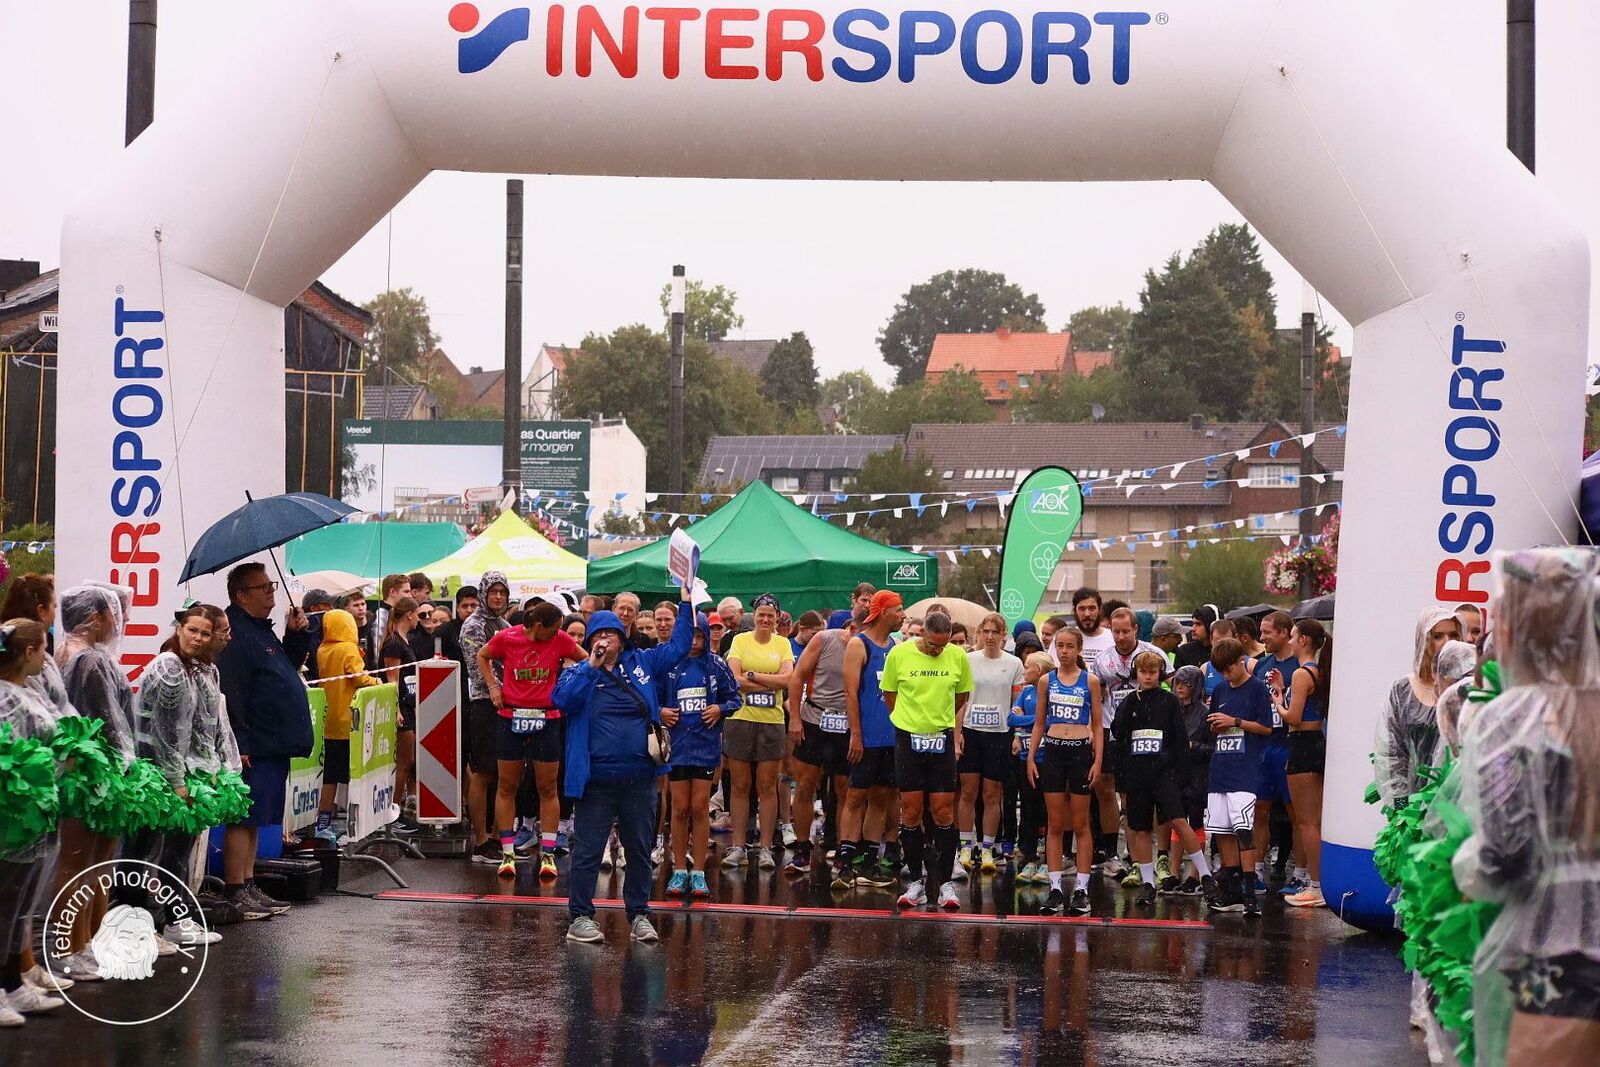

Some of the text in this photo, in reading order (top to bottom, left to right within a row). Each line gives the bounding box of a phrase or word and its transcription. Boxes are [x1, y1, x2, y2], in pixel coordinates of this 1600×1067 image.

[546, 4, 1151, 85] INTERSPORT
[521, 430, 583, 441] as Quartier
[529, 443, 574, 454] morgen
[1435, 325, 1506, 634] RSPORT
[1033, 493, 1070, 511] AOK
[893, 565, 920, 577] AOK
[520, 585, 549, 595] Strom
[910, 670, 918, 678] SC
[941, 670, 950, 678] LA
[680, 699, 707, 712] 1626
[747, 694, 774, 706] 1551
[972, 713, 998, 724] 1588
[1051, 705, 1080, 720] 1583
[514, 719, 544, 731] 1976
[914, 738, 944, 750] 1970
[1022, 737, 1045, 750] 152
[1061, 739, 1082, 747] PRO
[1133, 740, 1160, 752] 1533
[1216, 738, 1242, 751] 1627
